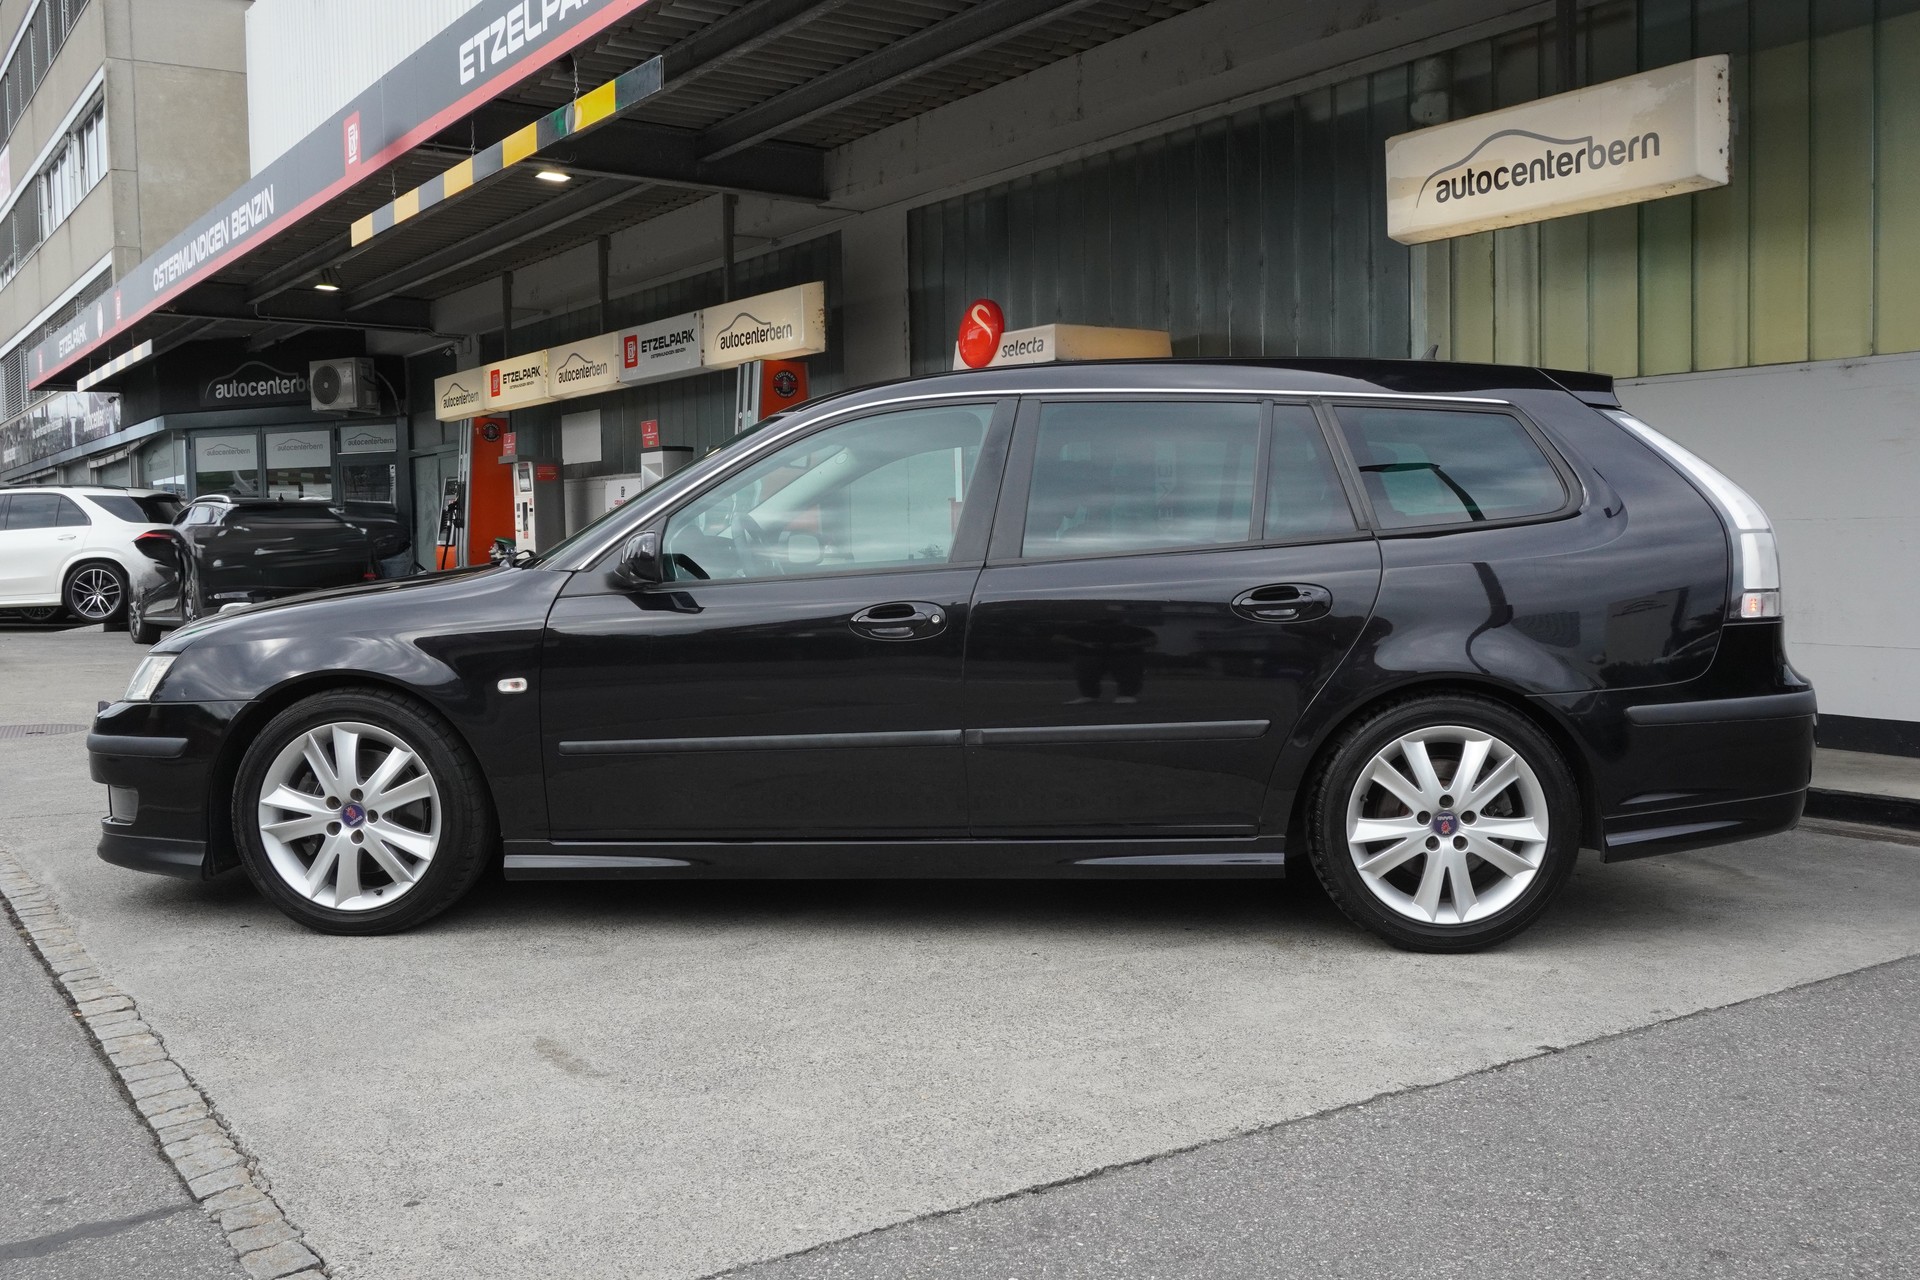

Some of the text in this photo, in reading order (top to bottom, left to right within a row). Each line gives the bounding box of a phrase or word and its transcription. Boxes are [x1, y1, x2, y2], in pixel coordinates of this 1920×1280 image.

[459, 0, 589, 85] ETZELPA
[1436, 132, 1660, 203] autocenterbern
[153, 184, 274, 292] OSTERMUNDIGEN BENZIN
[641, 328, 695, 353] ETZELPARK
[720, 323, 793, 350] autocenterbern
[1001, 337, 1044, 358] selecta
[502, 365, 541, 385] ETZELPARK
[558, 362, 608, 384] autocenterbern
[442, 391, 479, 408] autocenterbern
[206, 447, 251, 457] autocenterbern
[277, 442, 324, 452] autocenterbern
[347, 437, 394, 446] autocenterbern
